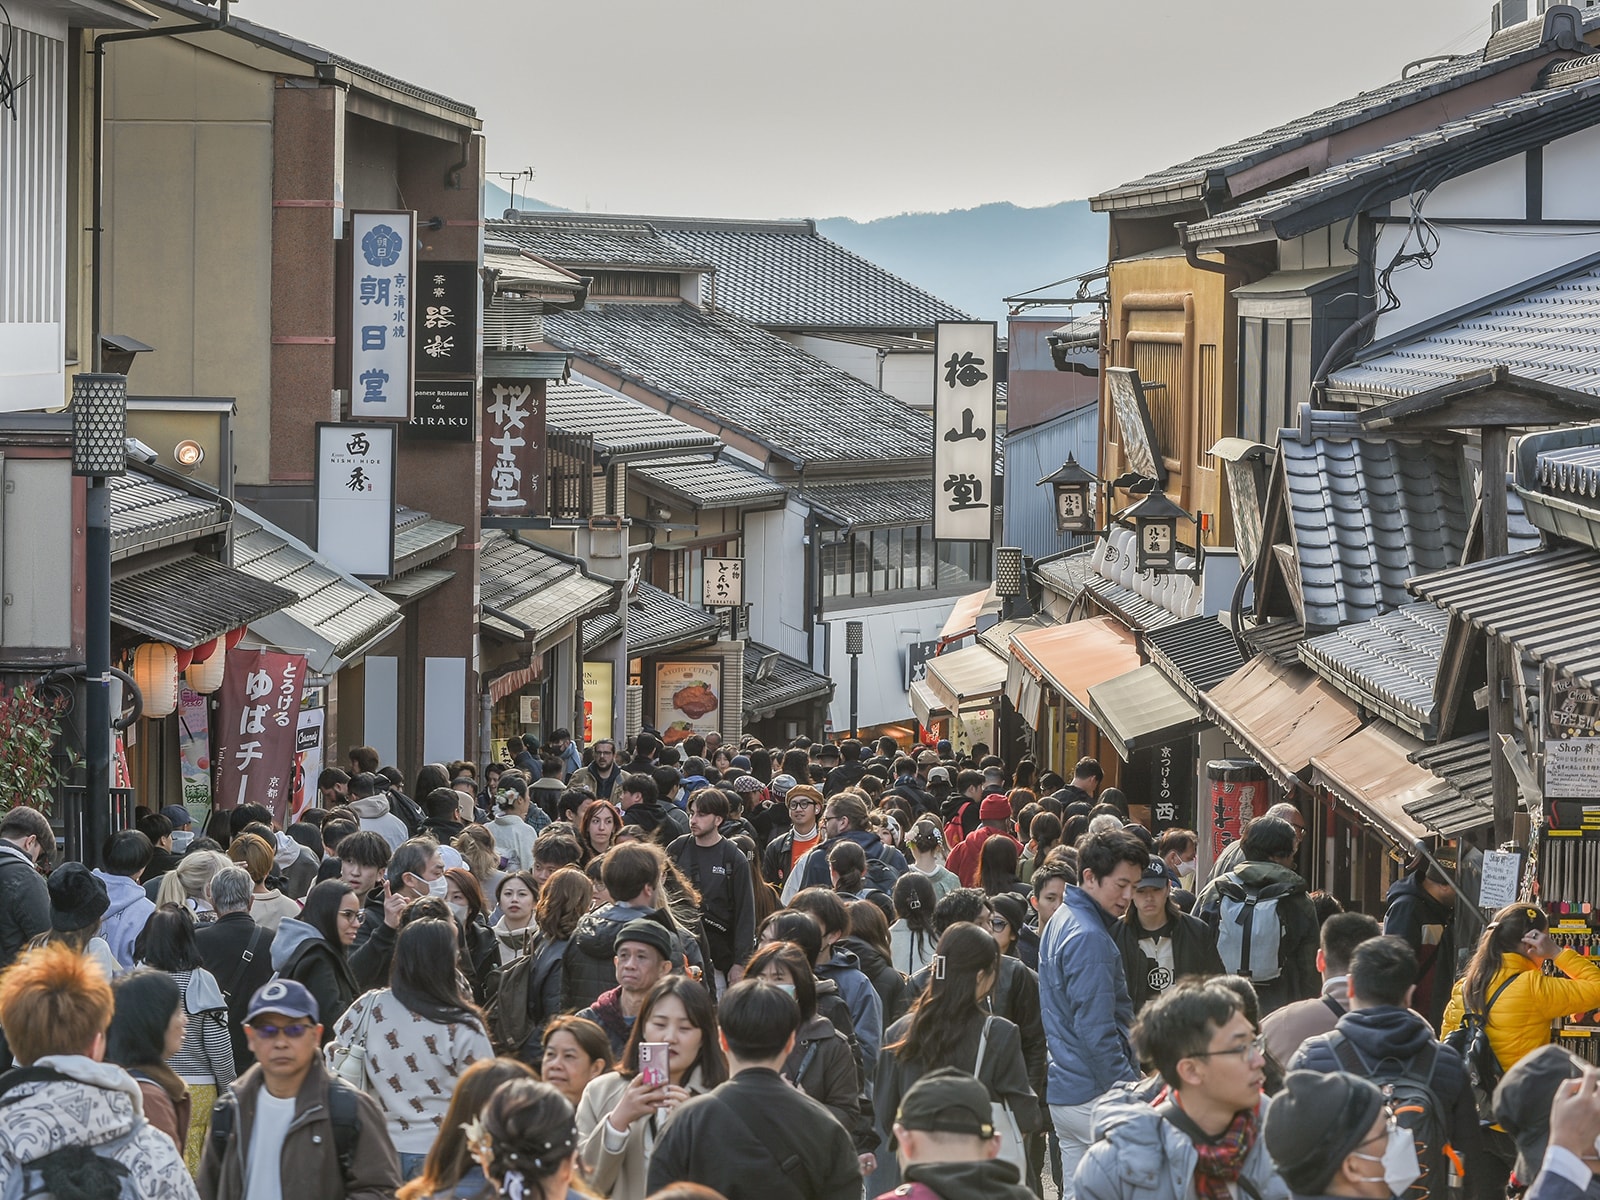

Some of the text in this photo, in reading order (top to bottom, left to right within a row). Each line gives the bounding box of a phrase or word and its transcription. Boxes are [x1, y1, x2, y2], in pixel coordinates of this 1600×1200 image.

[433, 274, 446, 298] 茶寮
[360, 275, 391, 403] 朝日堂
[424, 306, 456, 358] 器楽
[409, 417, 468, 426] KIRAKU
[486, 383, 531, 507] 桜士堂
[944, 351, 989, 512] 梅山堂
[345, 432, 370, 492] 西秀
[716, 561, 730, 599] とんかつ
[273, 662, 297, 727] とろける
[663, 666, 713, 677] KYOTO CUTLET
[1160, 746, 1172, 798] 京つけもの
[1558, 742, 1582, 755] Shop
